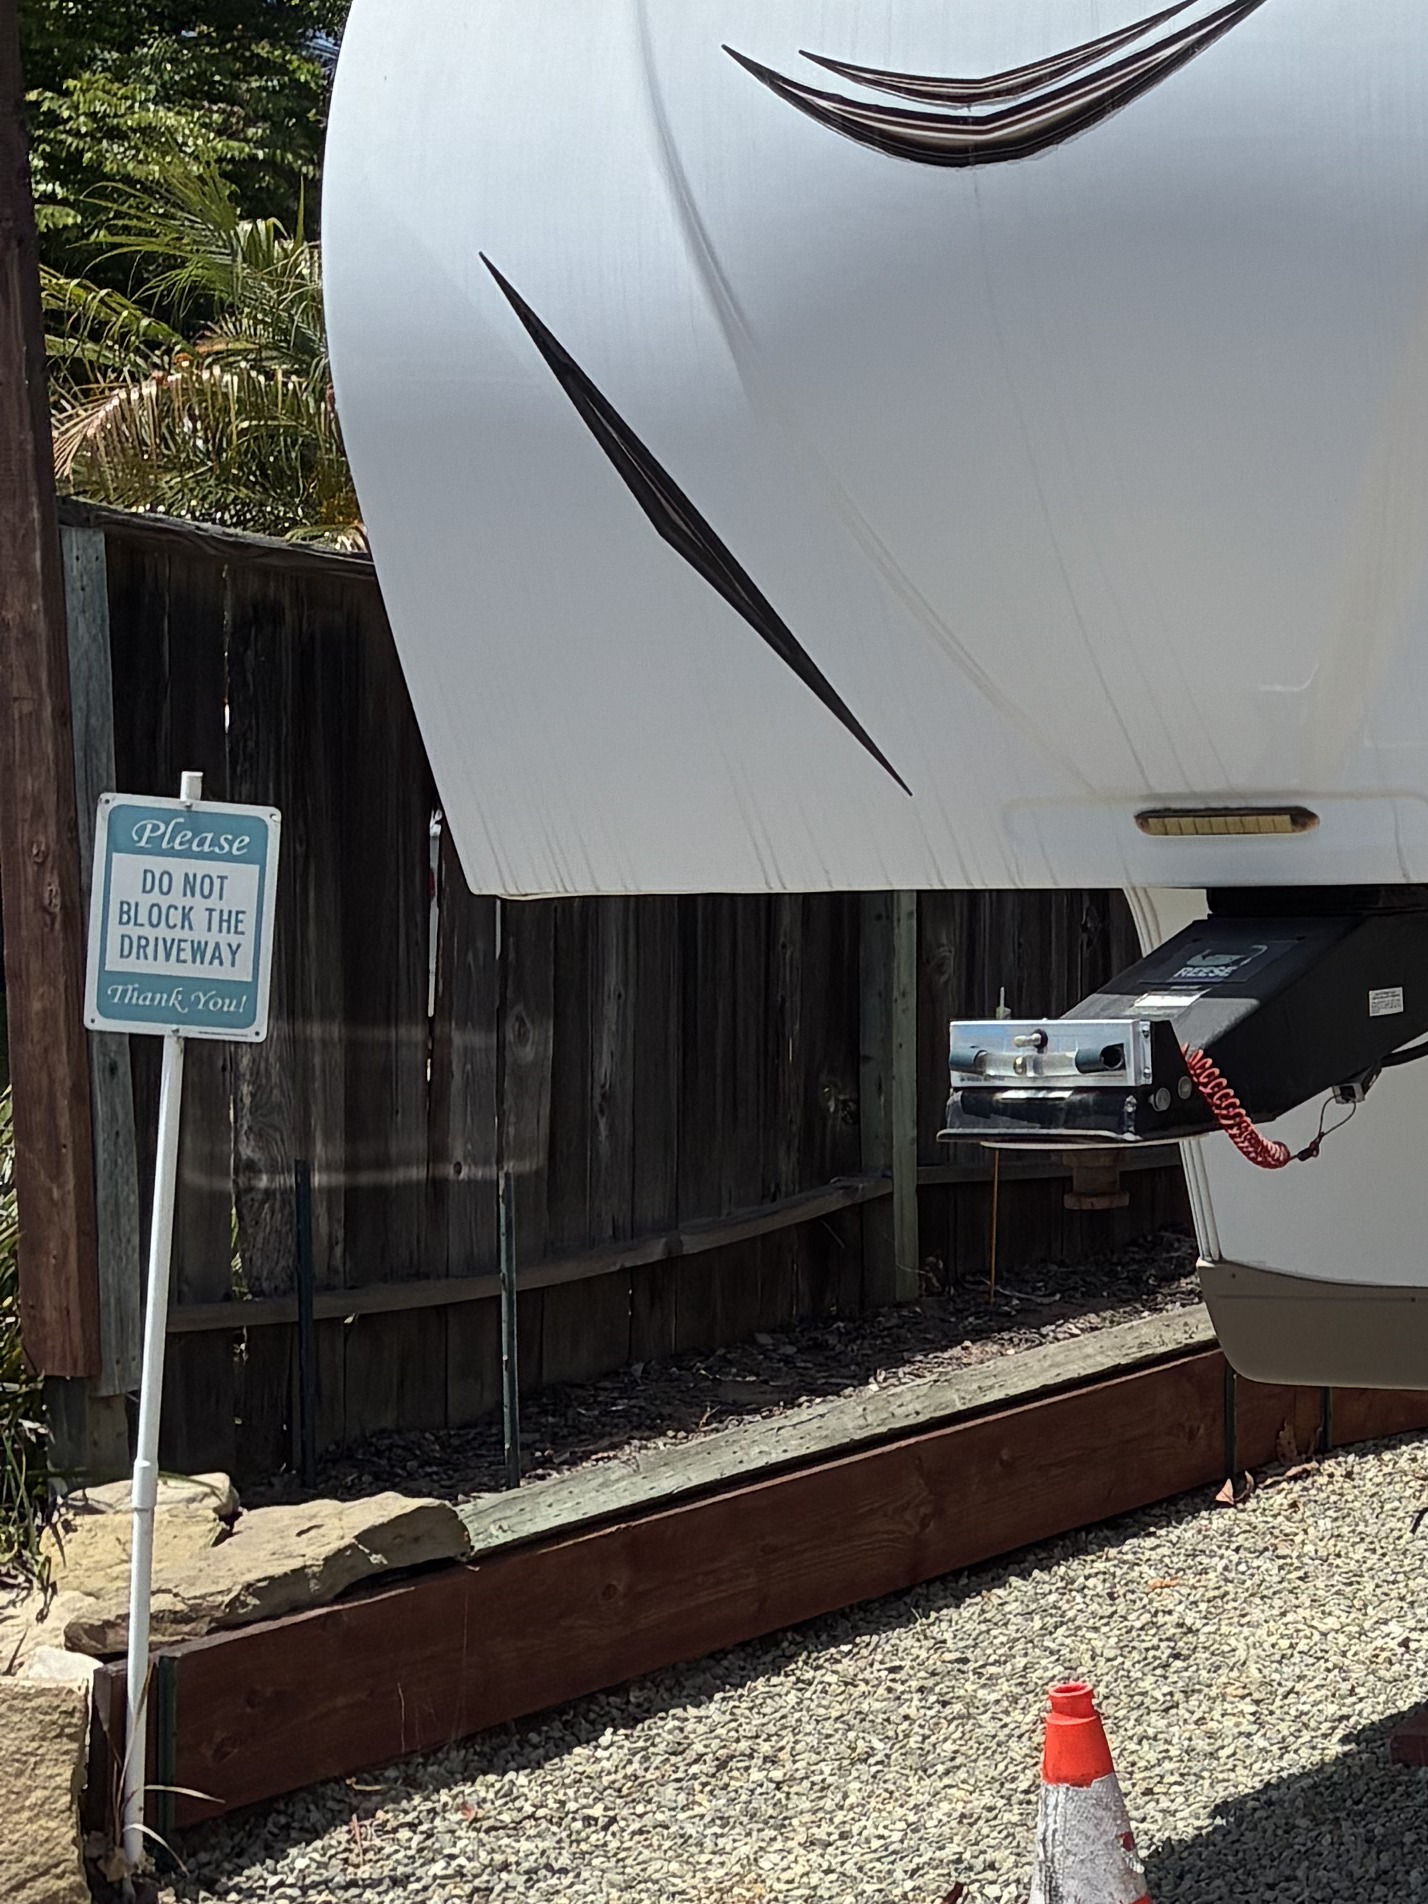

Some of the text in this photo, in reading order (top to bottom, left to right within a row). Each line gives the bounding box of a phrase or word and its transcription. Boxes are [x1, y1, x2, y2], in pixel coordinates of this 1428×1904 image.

[131, 817, 251, 856] Please
[142, 869, 228, 901] DO NOT
[118, 900, 247, 935] BLOCK THE
[119, 934, 242, 968] DRIVEWAY
[1173, 966, 1238, 978] REESE
[107, 983, 247, 1014] Thank You!
